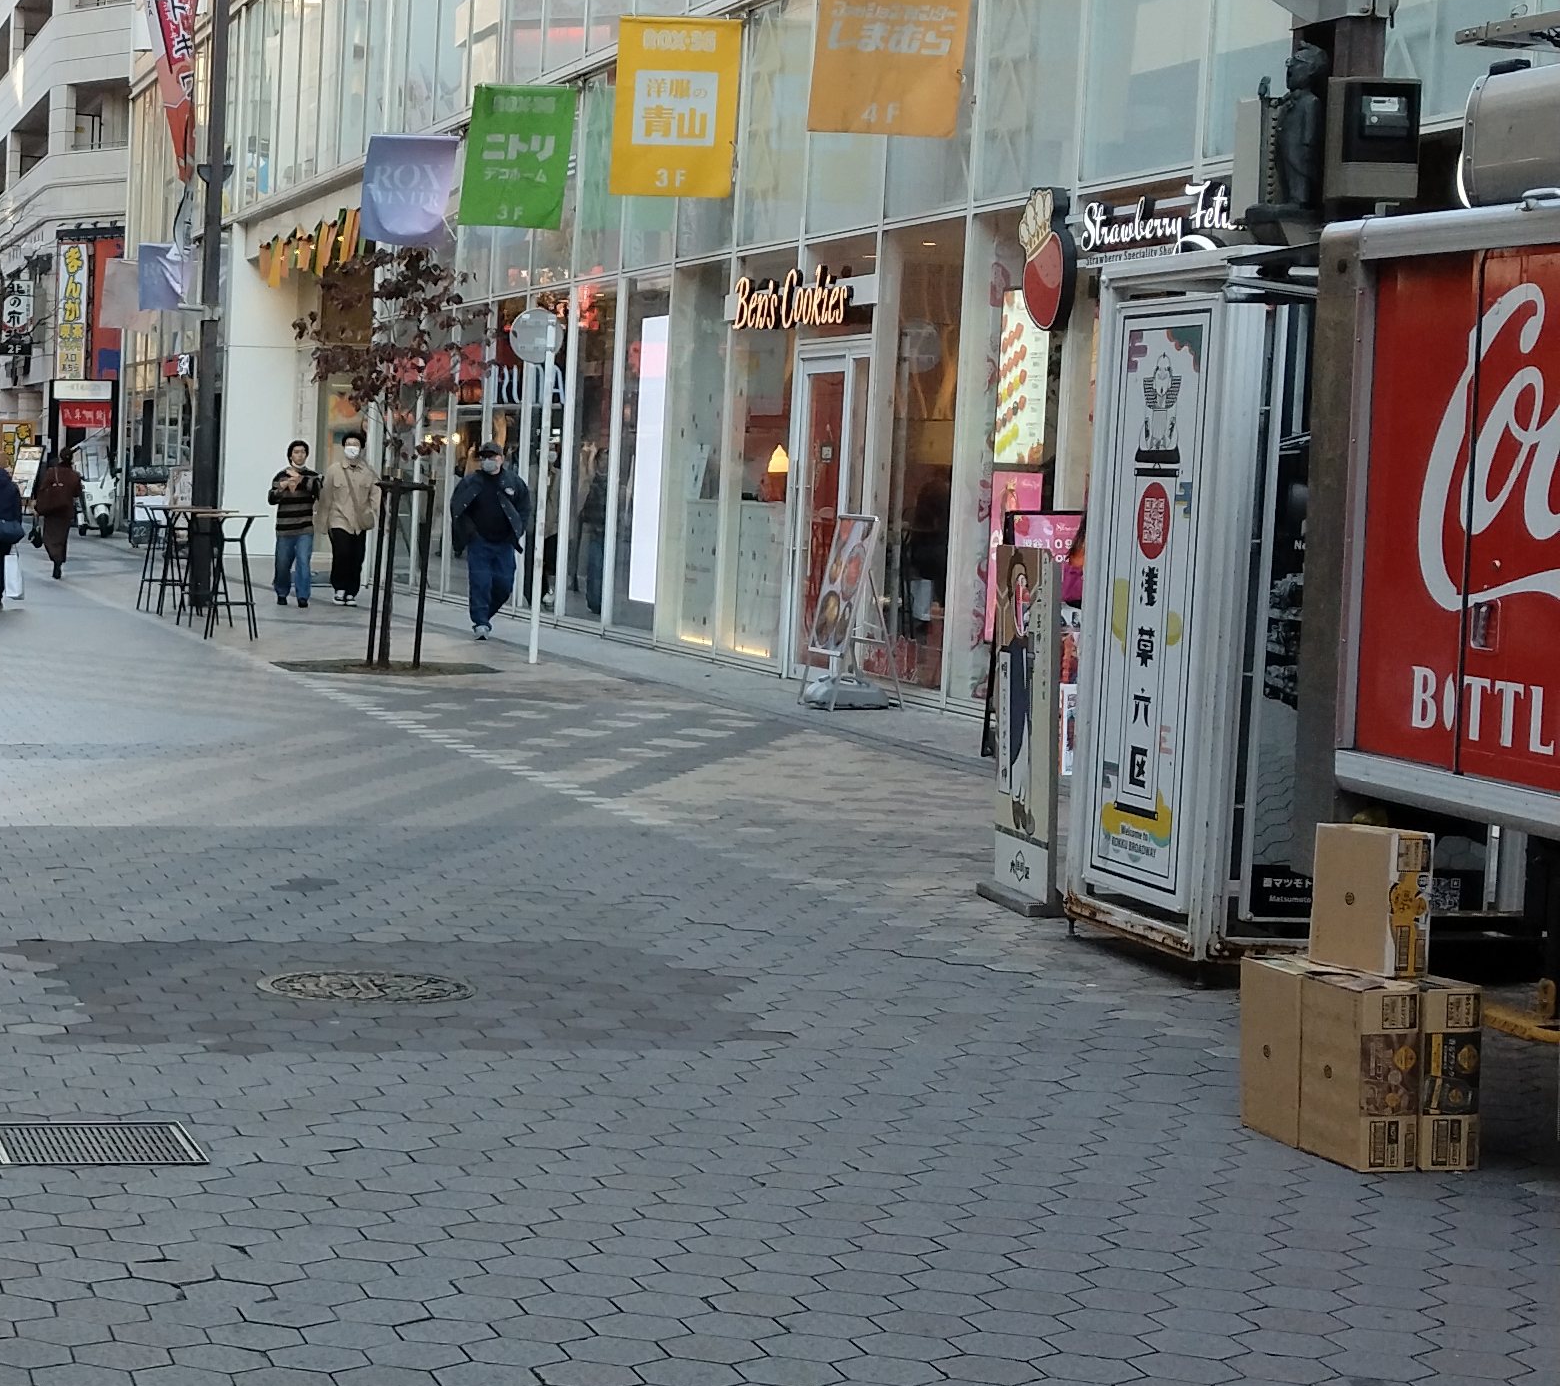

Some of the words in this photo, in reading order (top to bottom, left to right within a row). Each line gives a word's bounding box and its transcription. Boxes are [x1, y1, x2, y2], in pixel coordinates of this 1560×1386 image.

[827, 20, 956, 56] しまむら
[646, 77, 708, 99] 洋服の
[641, 103, 708, 140] 青山
[861, 101, 901, 124] 4F
[482, 133, 556, 163] ニトリ
[483, 166, 548, 184] デコホーム
[654, 168, 687, 188] 3F
[1081, 195, 1183, 256] Strawberry
[63, 245, 84, 323] まんが
[732, 276, 778, 330] Ben's
[780, 263, 848, 330] Cookies
[59, 323, 84, 339] 喫茶
[7, 344, 22, 354] 2F
[63, 353, 77, 363] 入口
[61, 363, 80, 373] あちら
[1128, 566, 1160, 789] 浅草六区
[1268, 894, 1312, 904] Matsumoto
